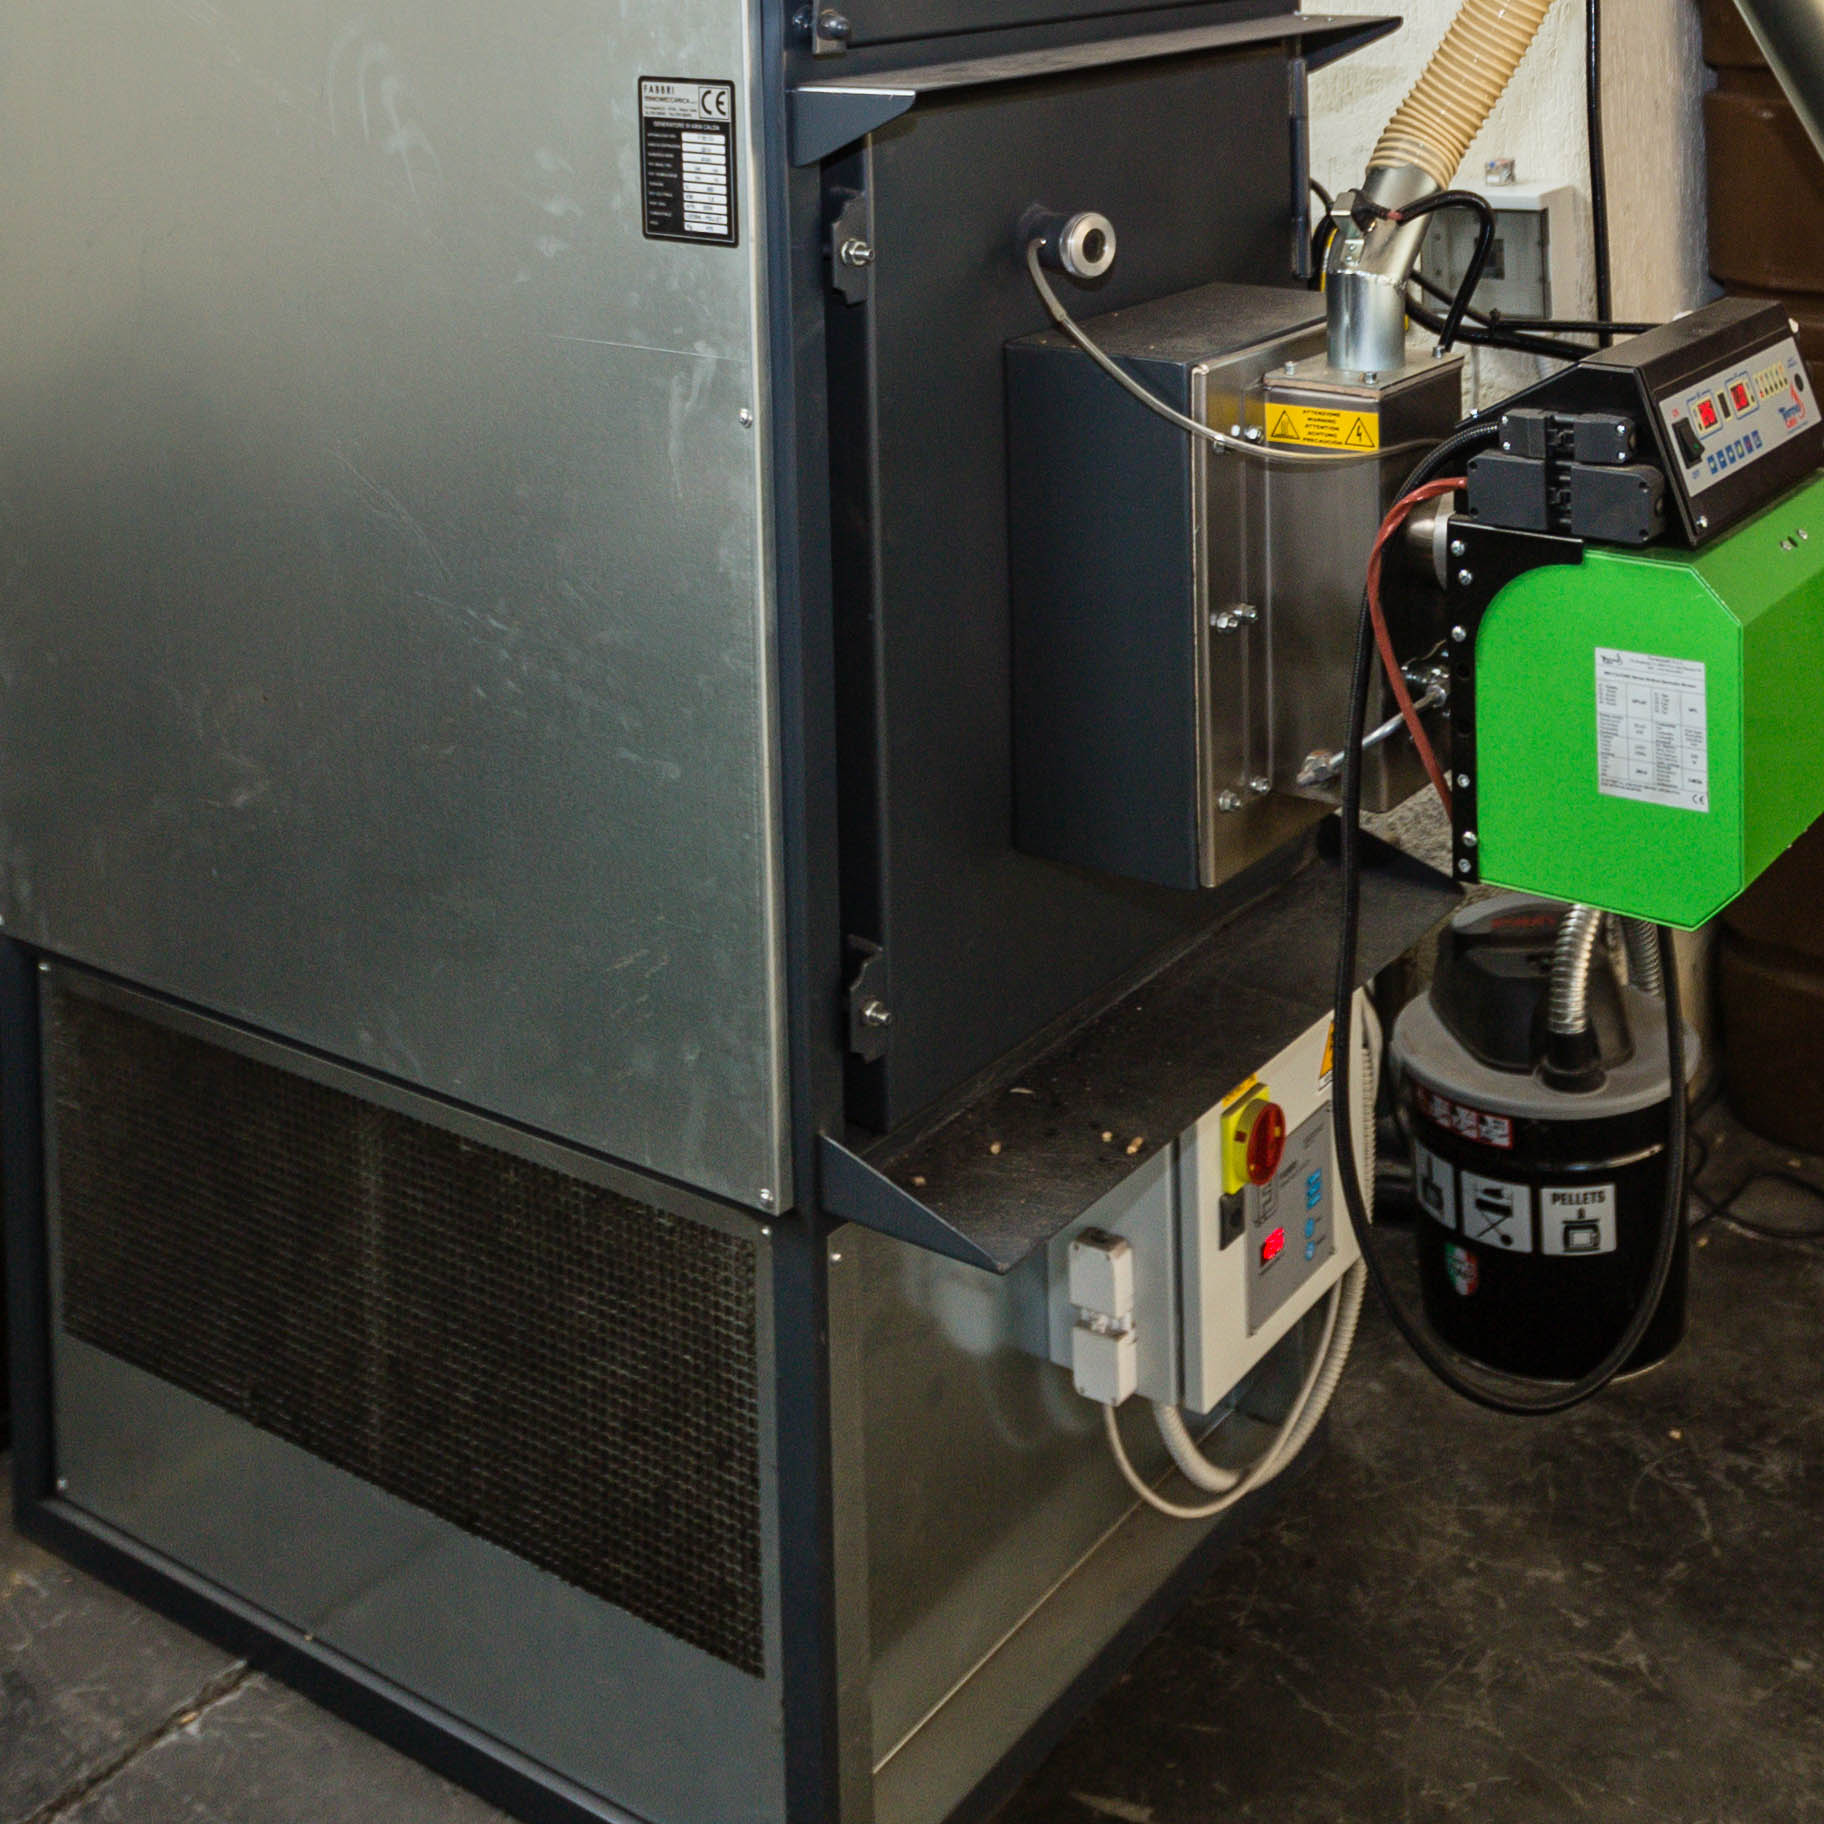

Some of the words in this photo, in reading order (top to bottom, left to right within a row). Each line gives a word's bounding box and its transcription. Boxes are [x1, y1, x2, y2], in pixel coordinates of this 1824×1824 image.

[644, 84, 674, 95] FABBRI
[701, 89, 727, 116] CE
[1551, 1190, 1606, 1206] PELLETS
